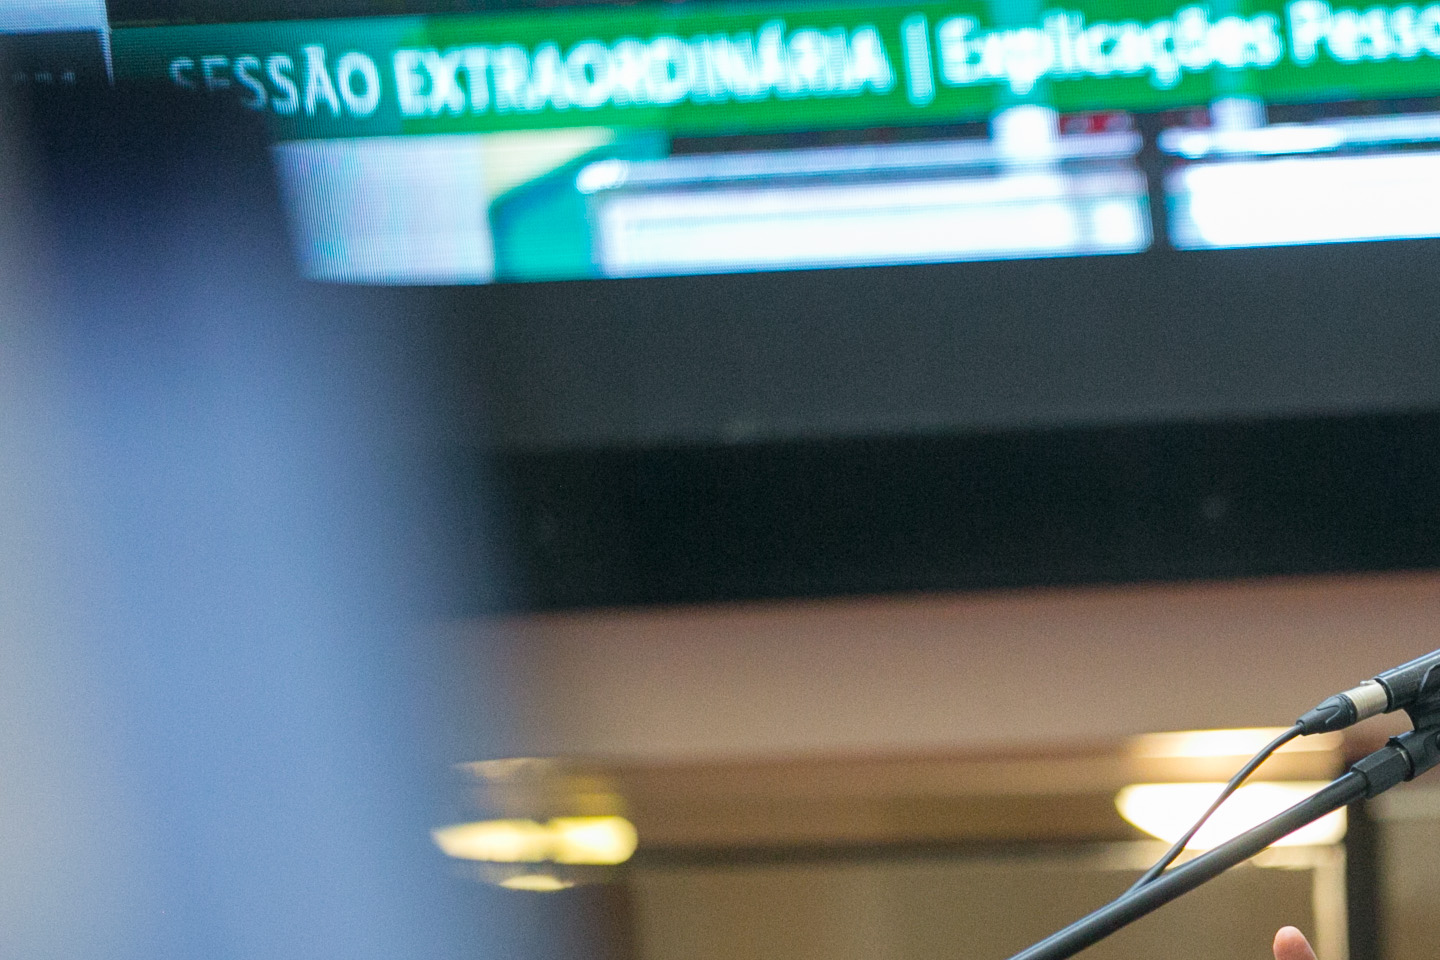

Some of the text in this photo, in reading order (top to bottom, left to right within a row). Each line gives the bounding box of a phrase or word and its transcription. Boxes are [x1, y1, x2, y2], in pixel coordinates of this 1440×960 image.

[168, 43, 380, 118] SESSÃO
[393, 19, 897, 117] EXTRAORDINÁRIA
[936, 7, 1283, 95] Explicações
